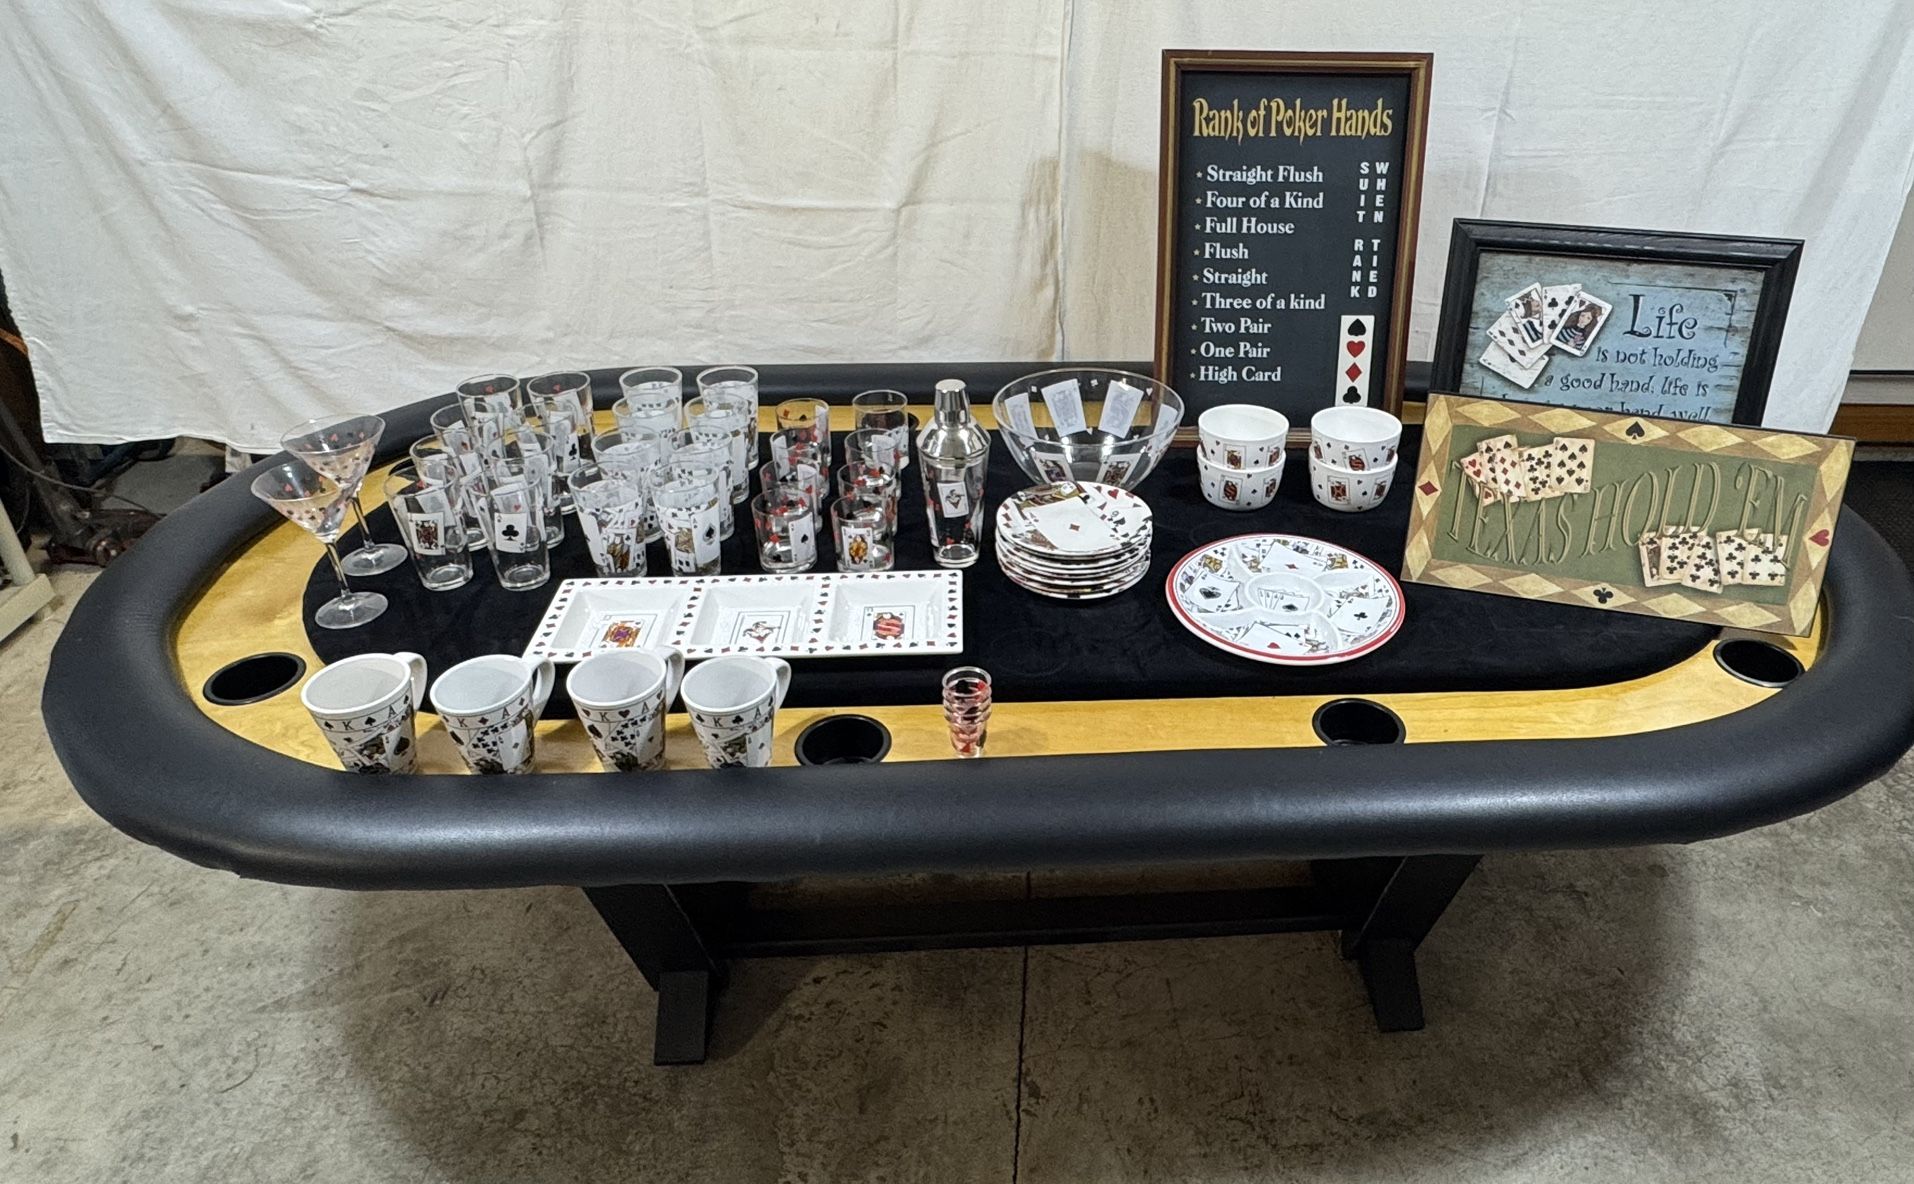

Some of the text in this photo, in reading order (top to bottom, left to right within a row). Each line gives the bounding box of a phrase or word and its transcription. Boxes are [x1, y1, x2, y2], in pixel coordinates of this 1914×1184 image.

[1193, 97, 1393, 146] Rank of Poker Hands
[1207, 164, 1324, 185] Straight Flush
[1206, 190, 1324, 209] Four of a Kind
[1204, 216, 1295, 234] Full House
[1350, 161, 1370, 298] SUIT RANK
[1367, 161, 1389, 298] WHEN TIED
[1203, 242, 1249, 260] Flush
[1203, 267, 1268, 288] Straight
[1202, 292, 1326, 310] Three of a kind
[1201, 317, 1272, 334] Two Pair
[1623, 293, 1698, 340] Life
[1200, 341, 1271, 358] One Pair
[1616, 349, 1647, 365] not
[1652, 346, 1719, 373] holding
[1199, 365, 1282, 384] High Card
[1544, 374, 1554, 387] a
[1559, 373, 1606, 391] good
[1660, 375, 1689, 396] life
[1447, 460, 1576, 566] TEXAS
[1580, 462, 1721, 559] HOLD
[342, 704, 397, 731] K A
[457, 706, 511, 728] K A
[600, 711, 610, 722] K
[712, 716, 723, 728] K
